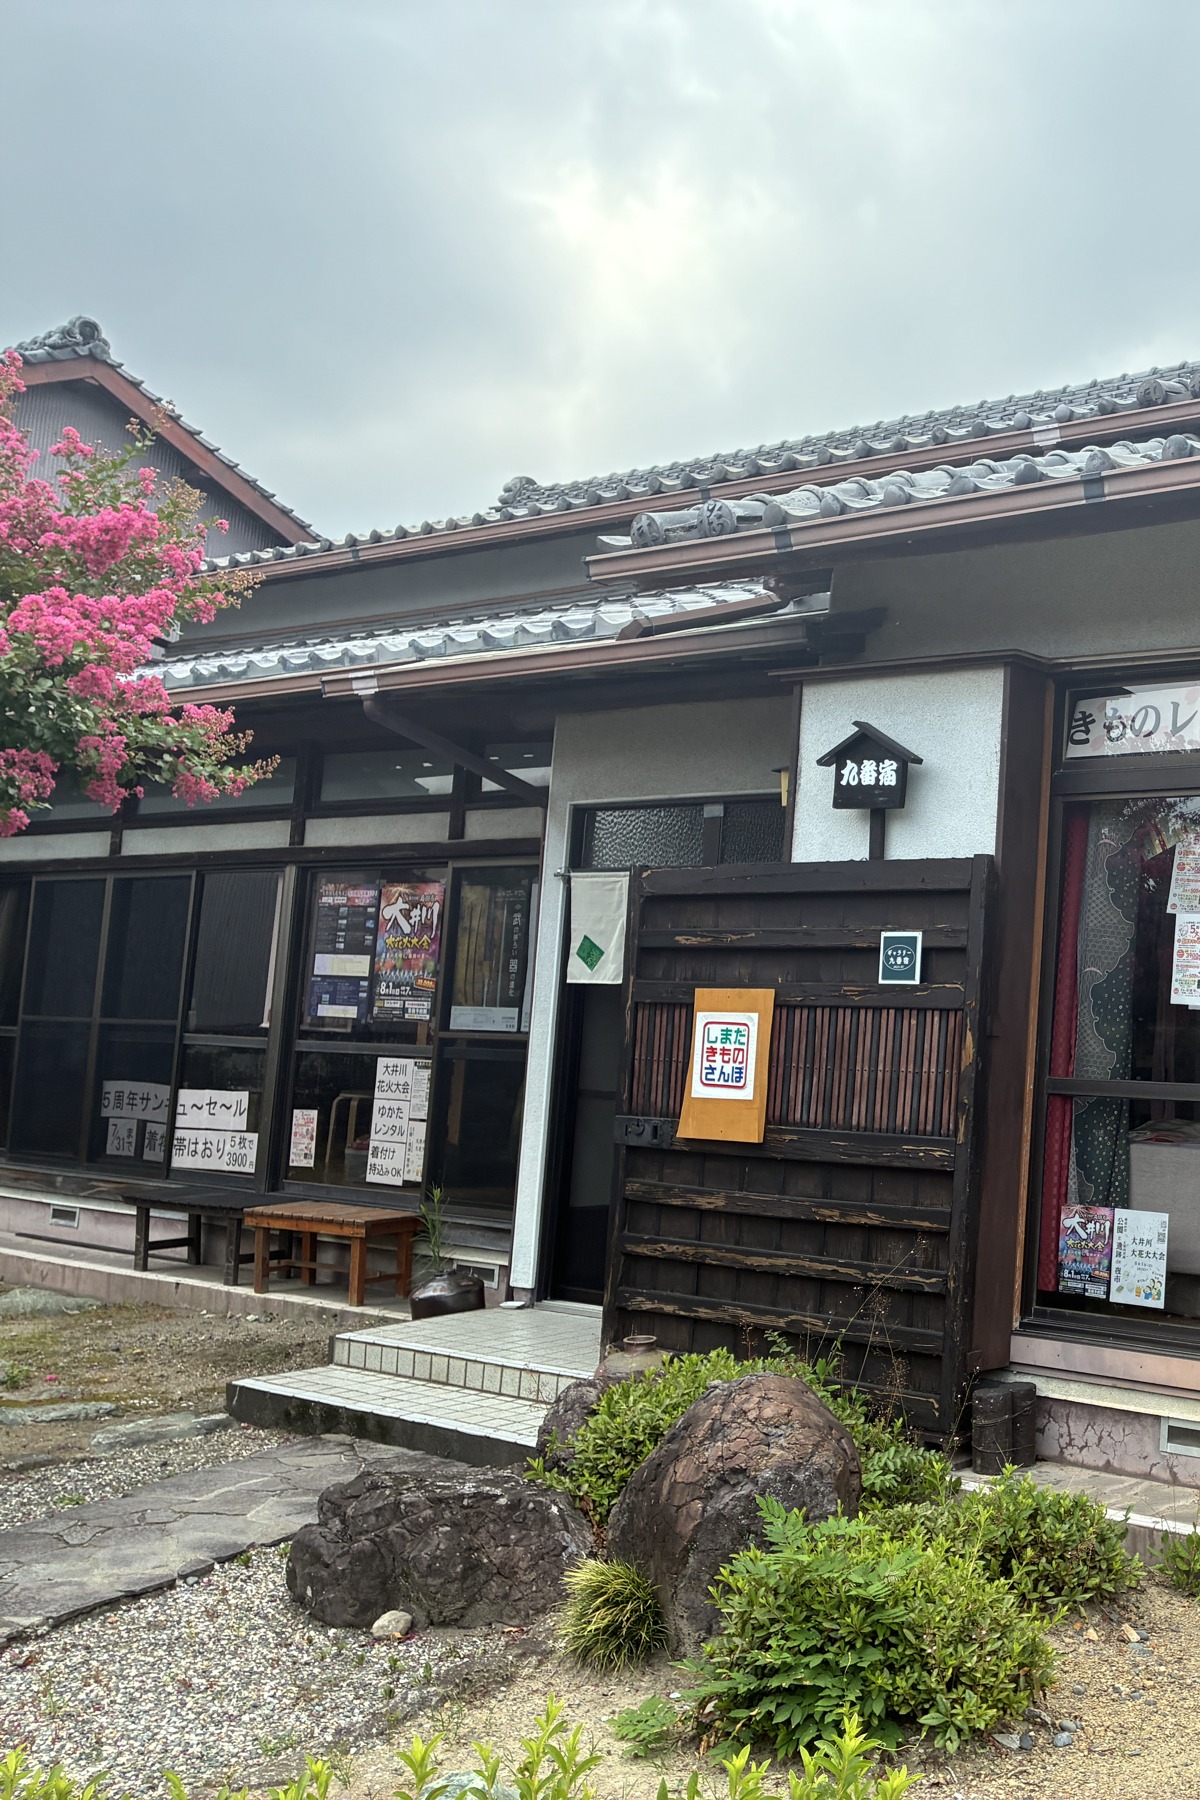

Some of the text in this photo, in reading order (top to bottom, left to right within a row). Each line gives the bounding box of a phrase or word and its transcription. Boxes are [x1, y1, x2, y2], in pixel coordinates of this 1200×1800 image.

[840, 759, 898, 787] 九番宿
[707, 1027, 746, 1046] しまだ
[705, 1046, 745, 1065] きもの
[382, 1062, 408, 1077] 大井川
[704, 1064, 744, 1084] さんぽ
[377, 1080, 410, 1094] 花火大会
[102, 1090, 169, 1113] 5周年サン
[378, 1105, 404, 1120] ゆかた
[374, 1123, 405, 1138] レンタル
[174, 1135, 254, 1160] 帯はおり 5枚で
[370, 1145, 396, 1160] 着付け
[1062, 1213, 1111, 1245] 大井川
[1131, 1236, 1153, 1248] 大井川
[1130, 1249, 1166, 1261] 大花火大会
